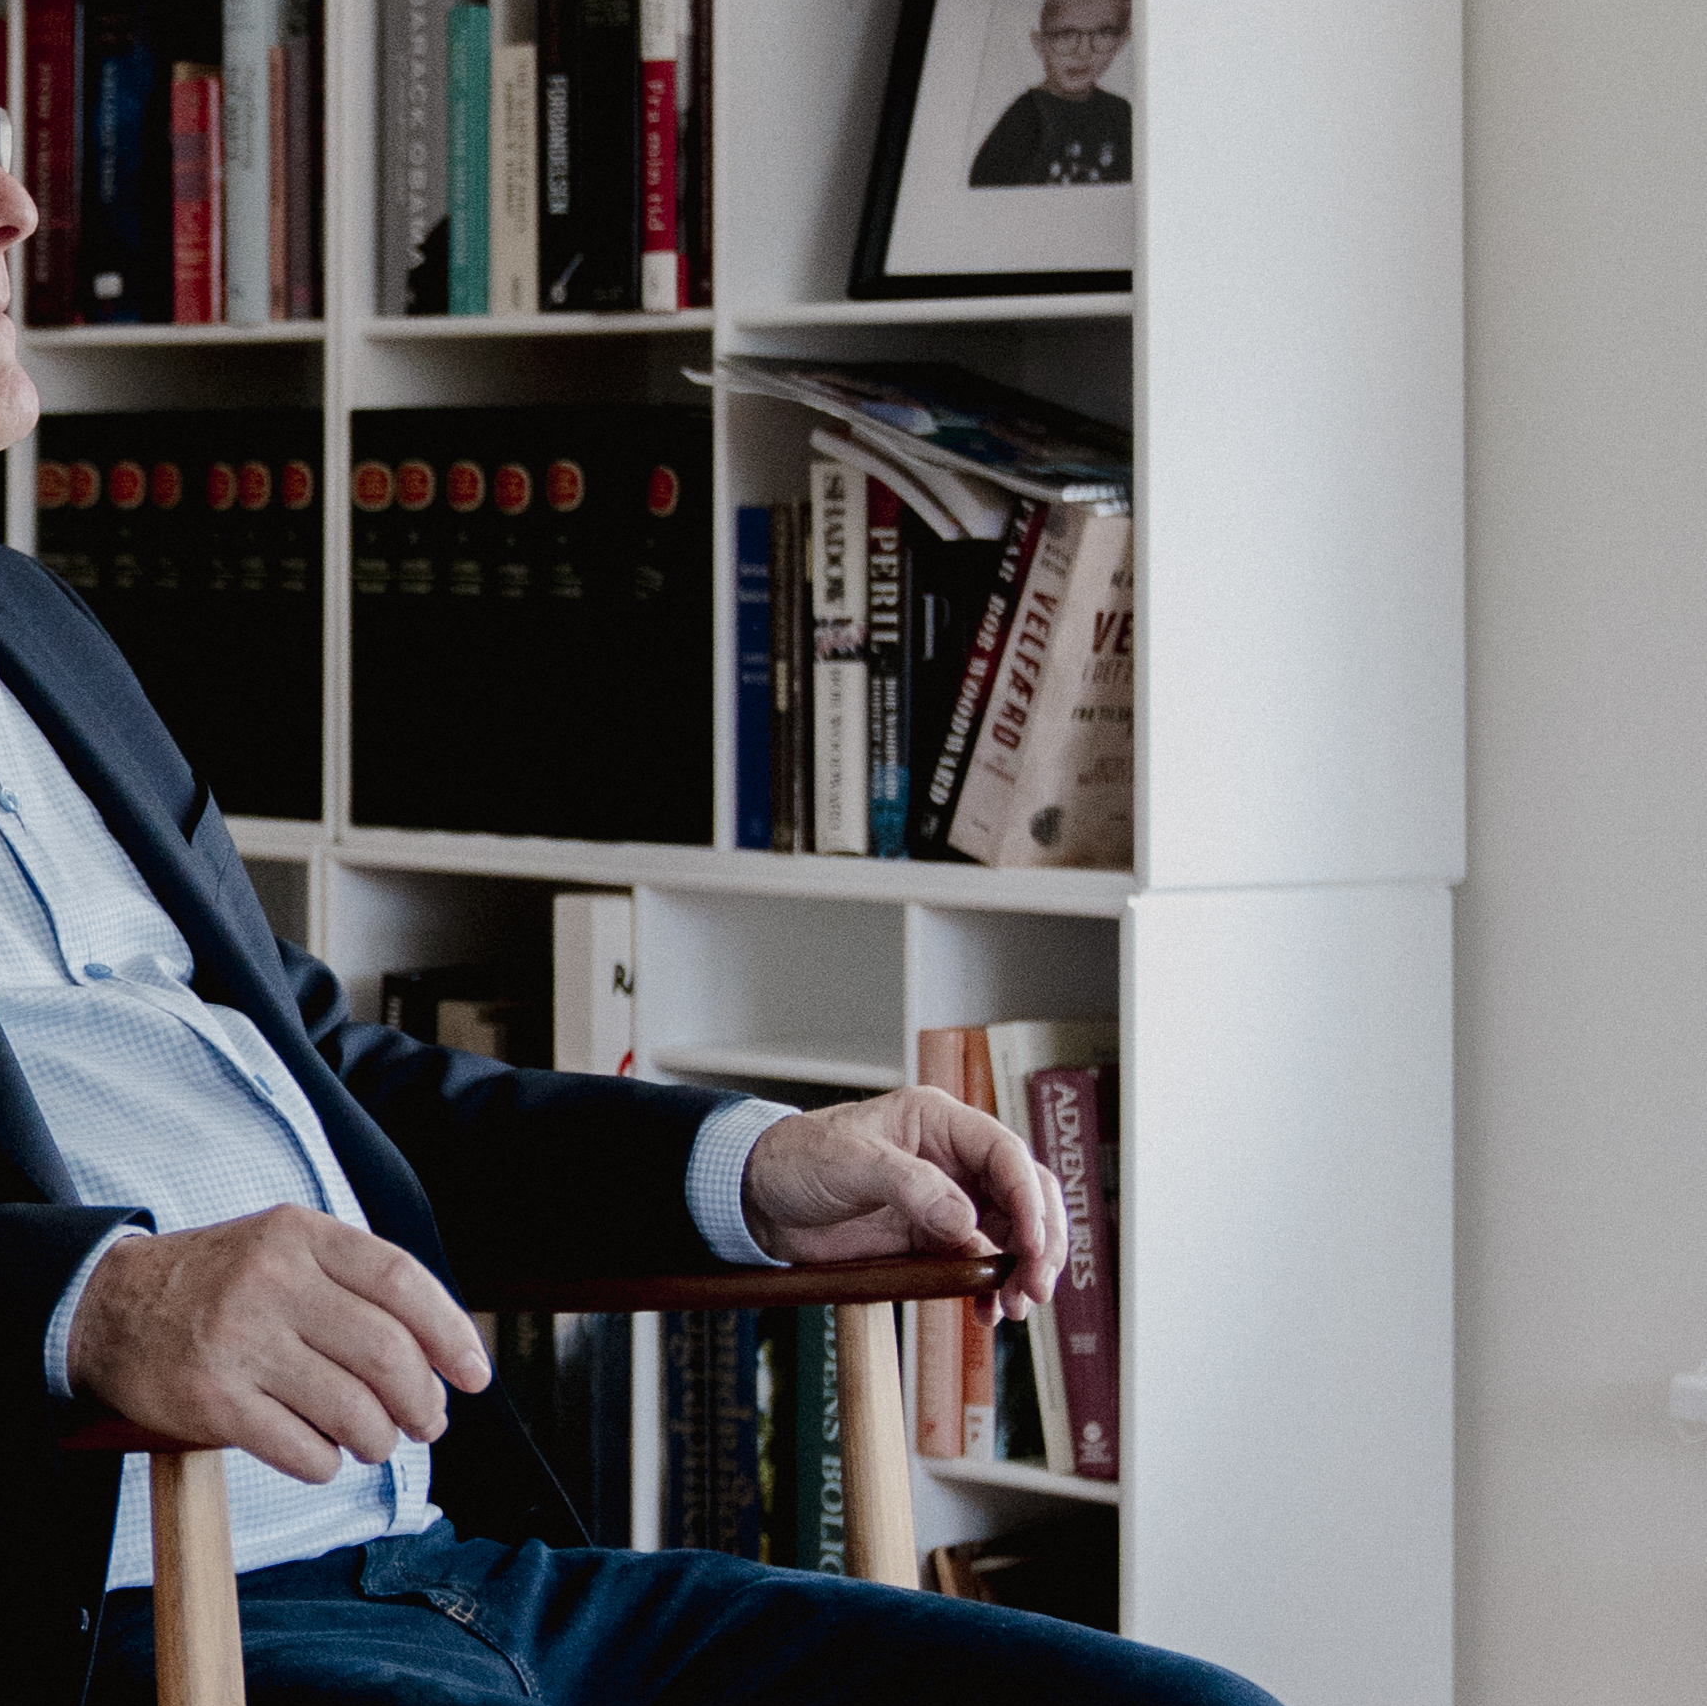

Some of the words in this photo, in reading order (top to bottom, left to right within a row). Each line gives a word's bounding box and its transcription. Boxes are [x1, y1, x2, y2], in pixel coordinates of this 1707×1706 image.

[647, 78, 665, 125] Fra
[408, 142, 426, 269] OBAMA
[647, 194, 665, 233] tid
[869, 526, 900, 655] PERIL
[976, 592, 1008, 654] BOB
[930, 657, 990, 806] WOODWARD
[991, 589, 1059, 752] VELFÆRD
[1053, 1082, 1097, 1291] ADVENTURES
